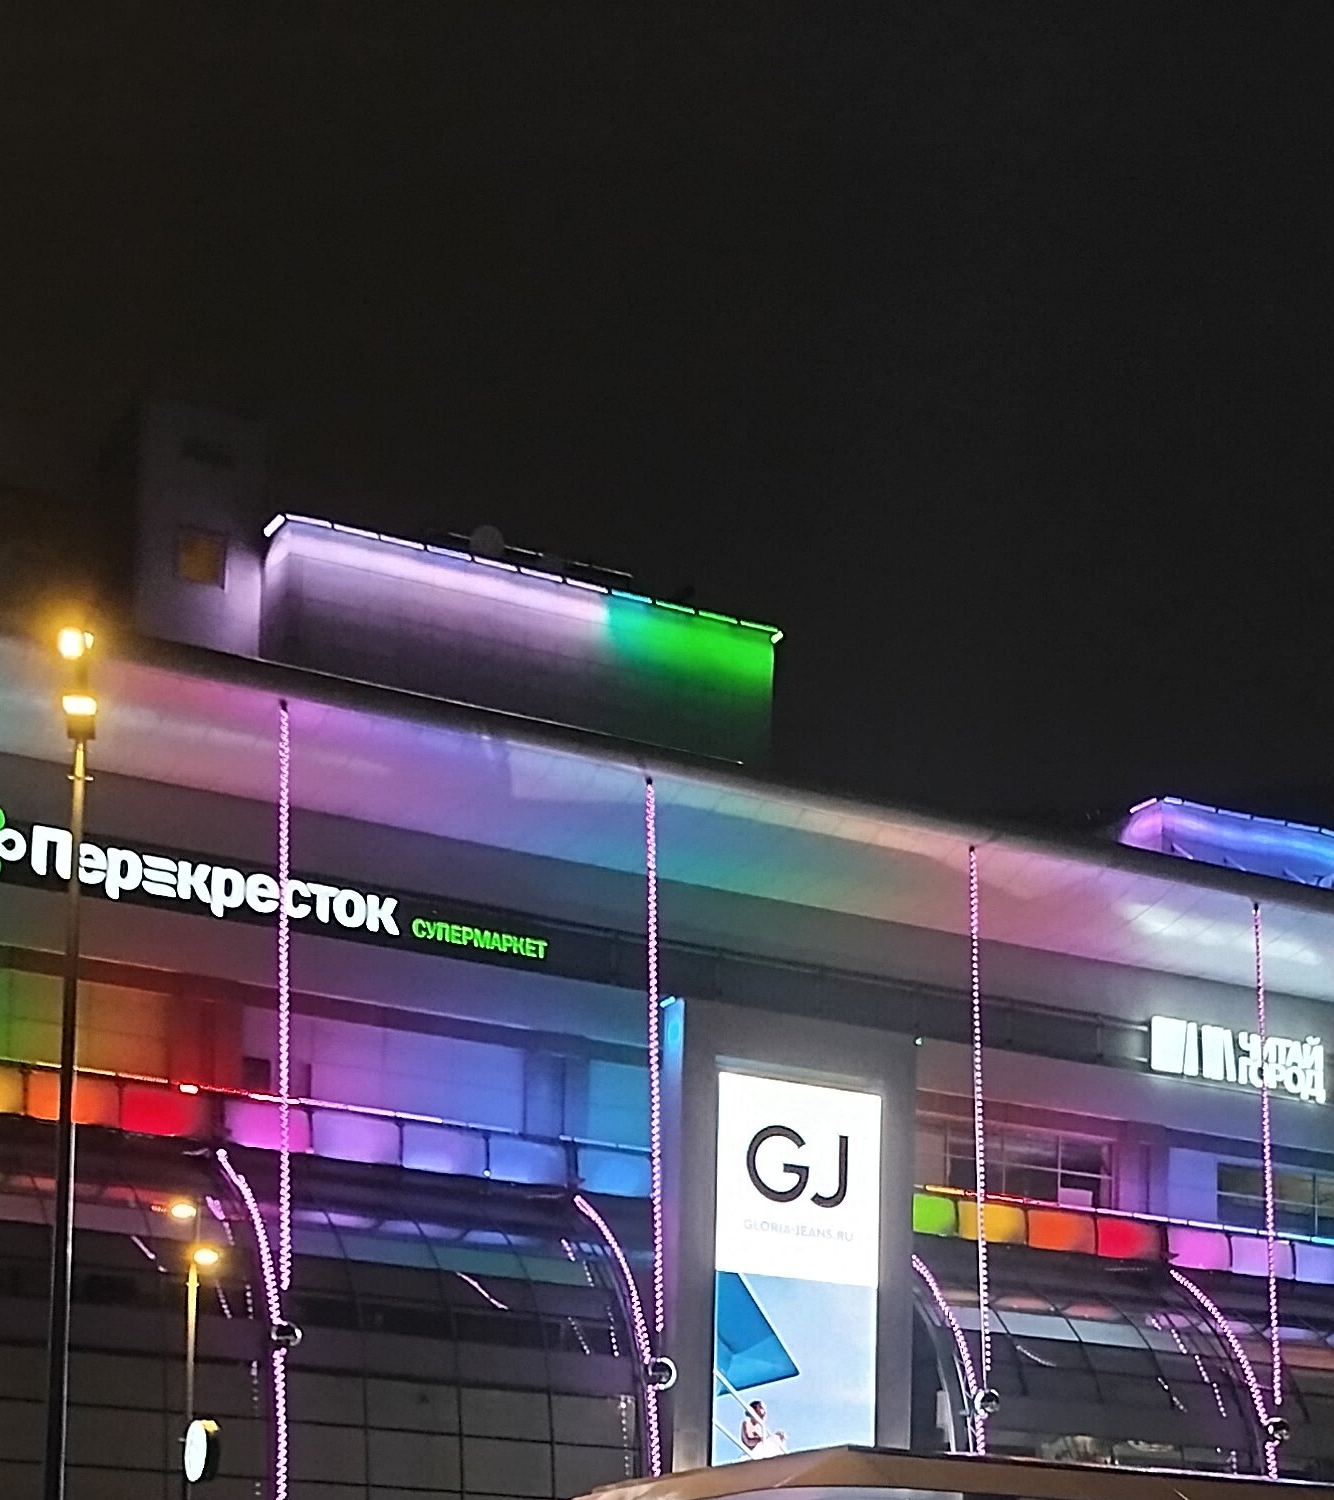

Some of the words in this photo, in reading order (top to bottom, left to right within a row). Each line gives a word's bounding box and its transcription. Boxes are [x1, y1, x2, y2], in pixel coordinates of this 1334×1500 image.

[32, 825, 399, 936] Перекресток
[412, 918, 548, 959] СУПЕРМАРКЕТ
[1238, 1031, 1324, 1069] ЧИТАЙ
[1238, 1056, 1326, 1104] ГОРОД
[746, 1125, 849, 1208] GJ
